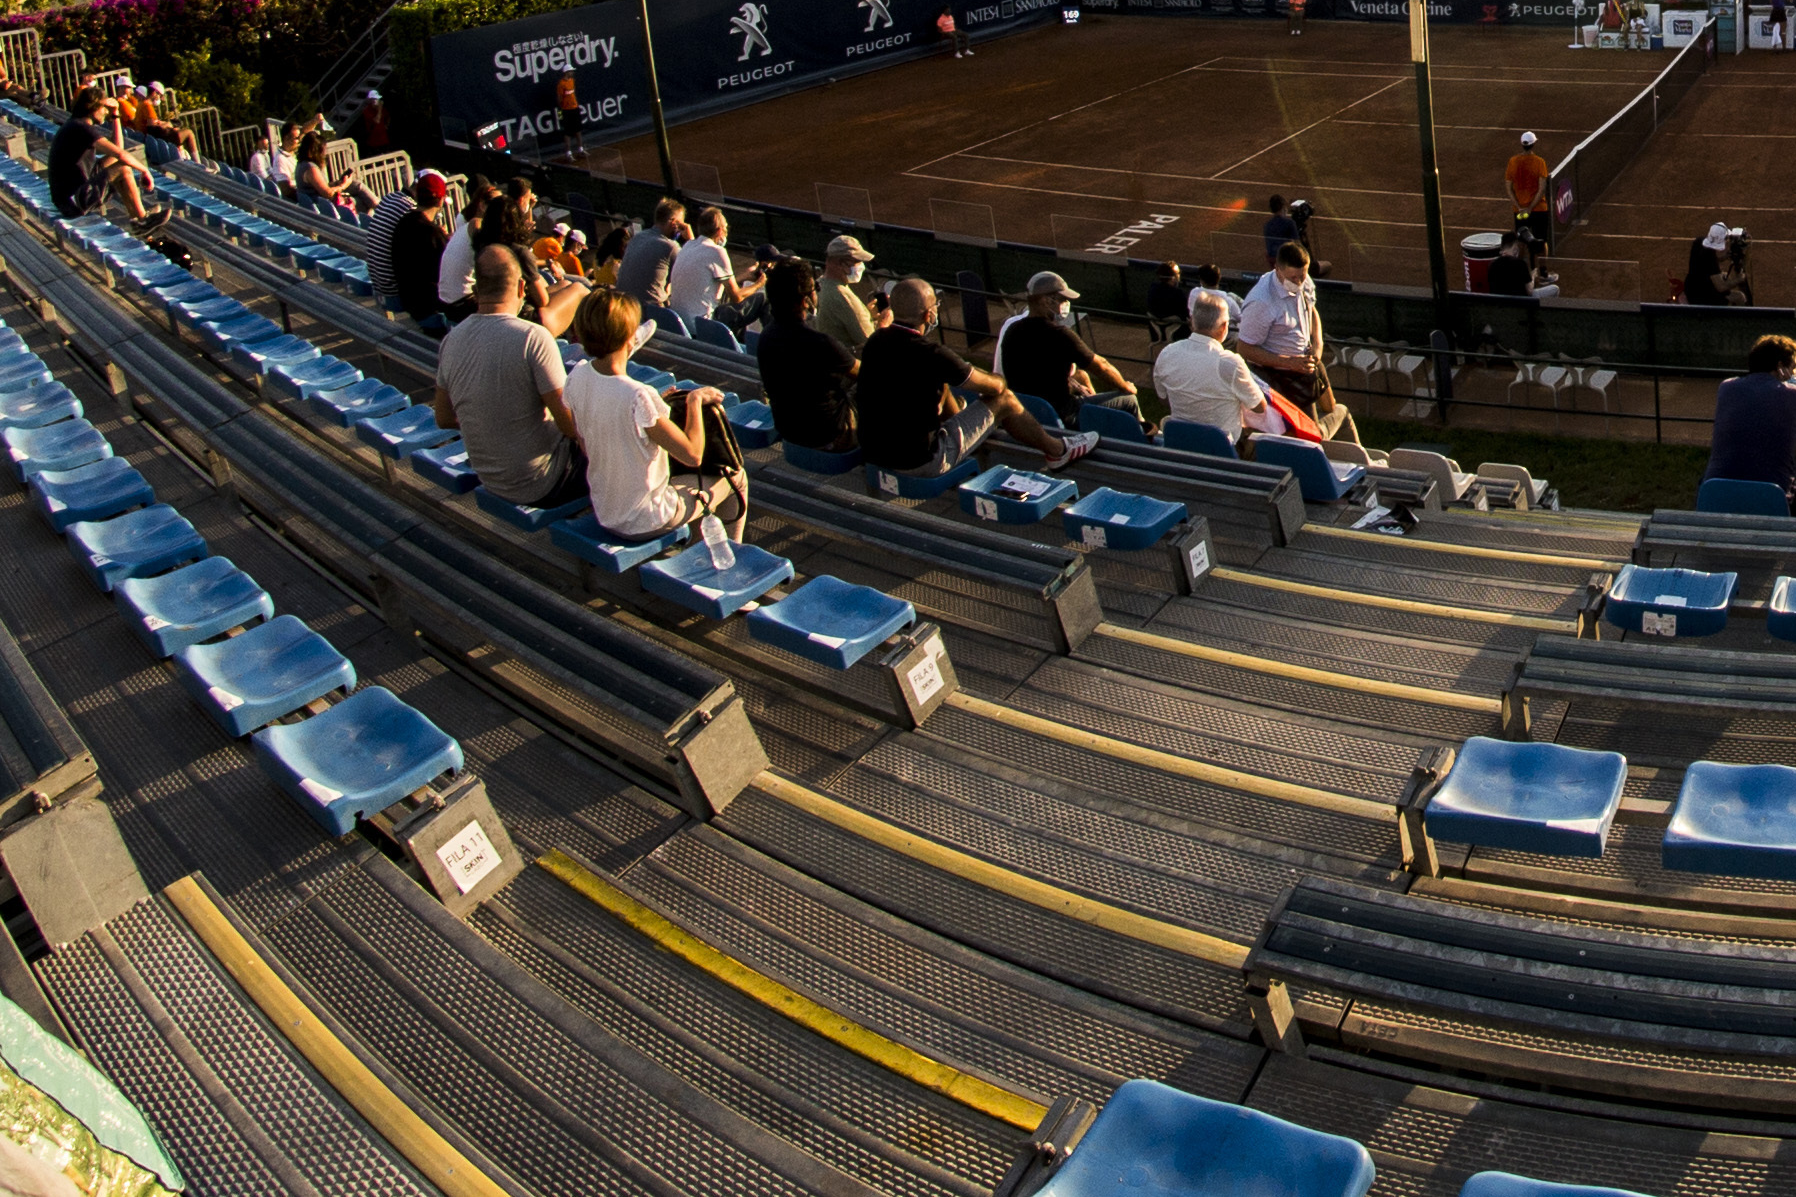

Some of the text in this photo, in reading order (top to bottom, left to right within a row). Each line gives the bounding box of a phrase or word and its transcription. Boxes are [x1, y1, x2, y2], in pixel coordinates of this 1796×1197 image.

[966, 4, 1000, 26] INTESA
[1351, 0, 1452, 17] Veneta Cine
[1523, 5, 1597, 17] PEUGEOT
[846, 32, 912, 57] PEUGEOT
[493, 34, 620, 84] Superdry.
[717, 60, 796, 90] PEUGEOT
[1556, 188, 1574, 215] WTA
[445, 831, 485, 868] FILA 11
[463, 852, 484, 873] SKIN
